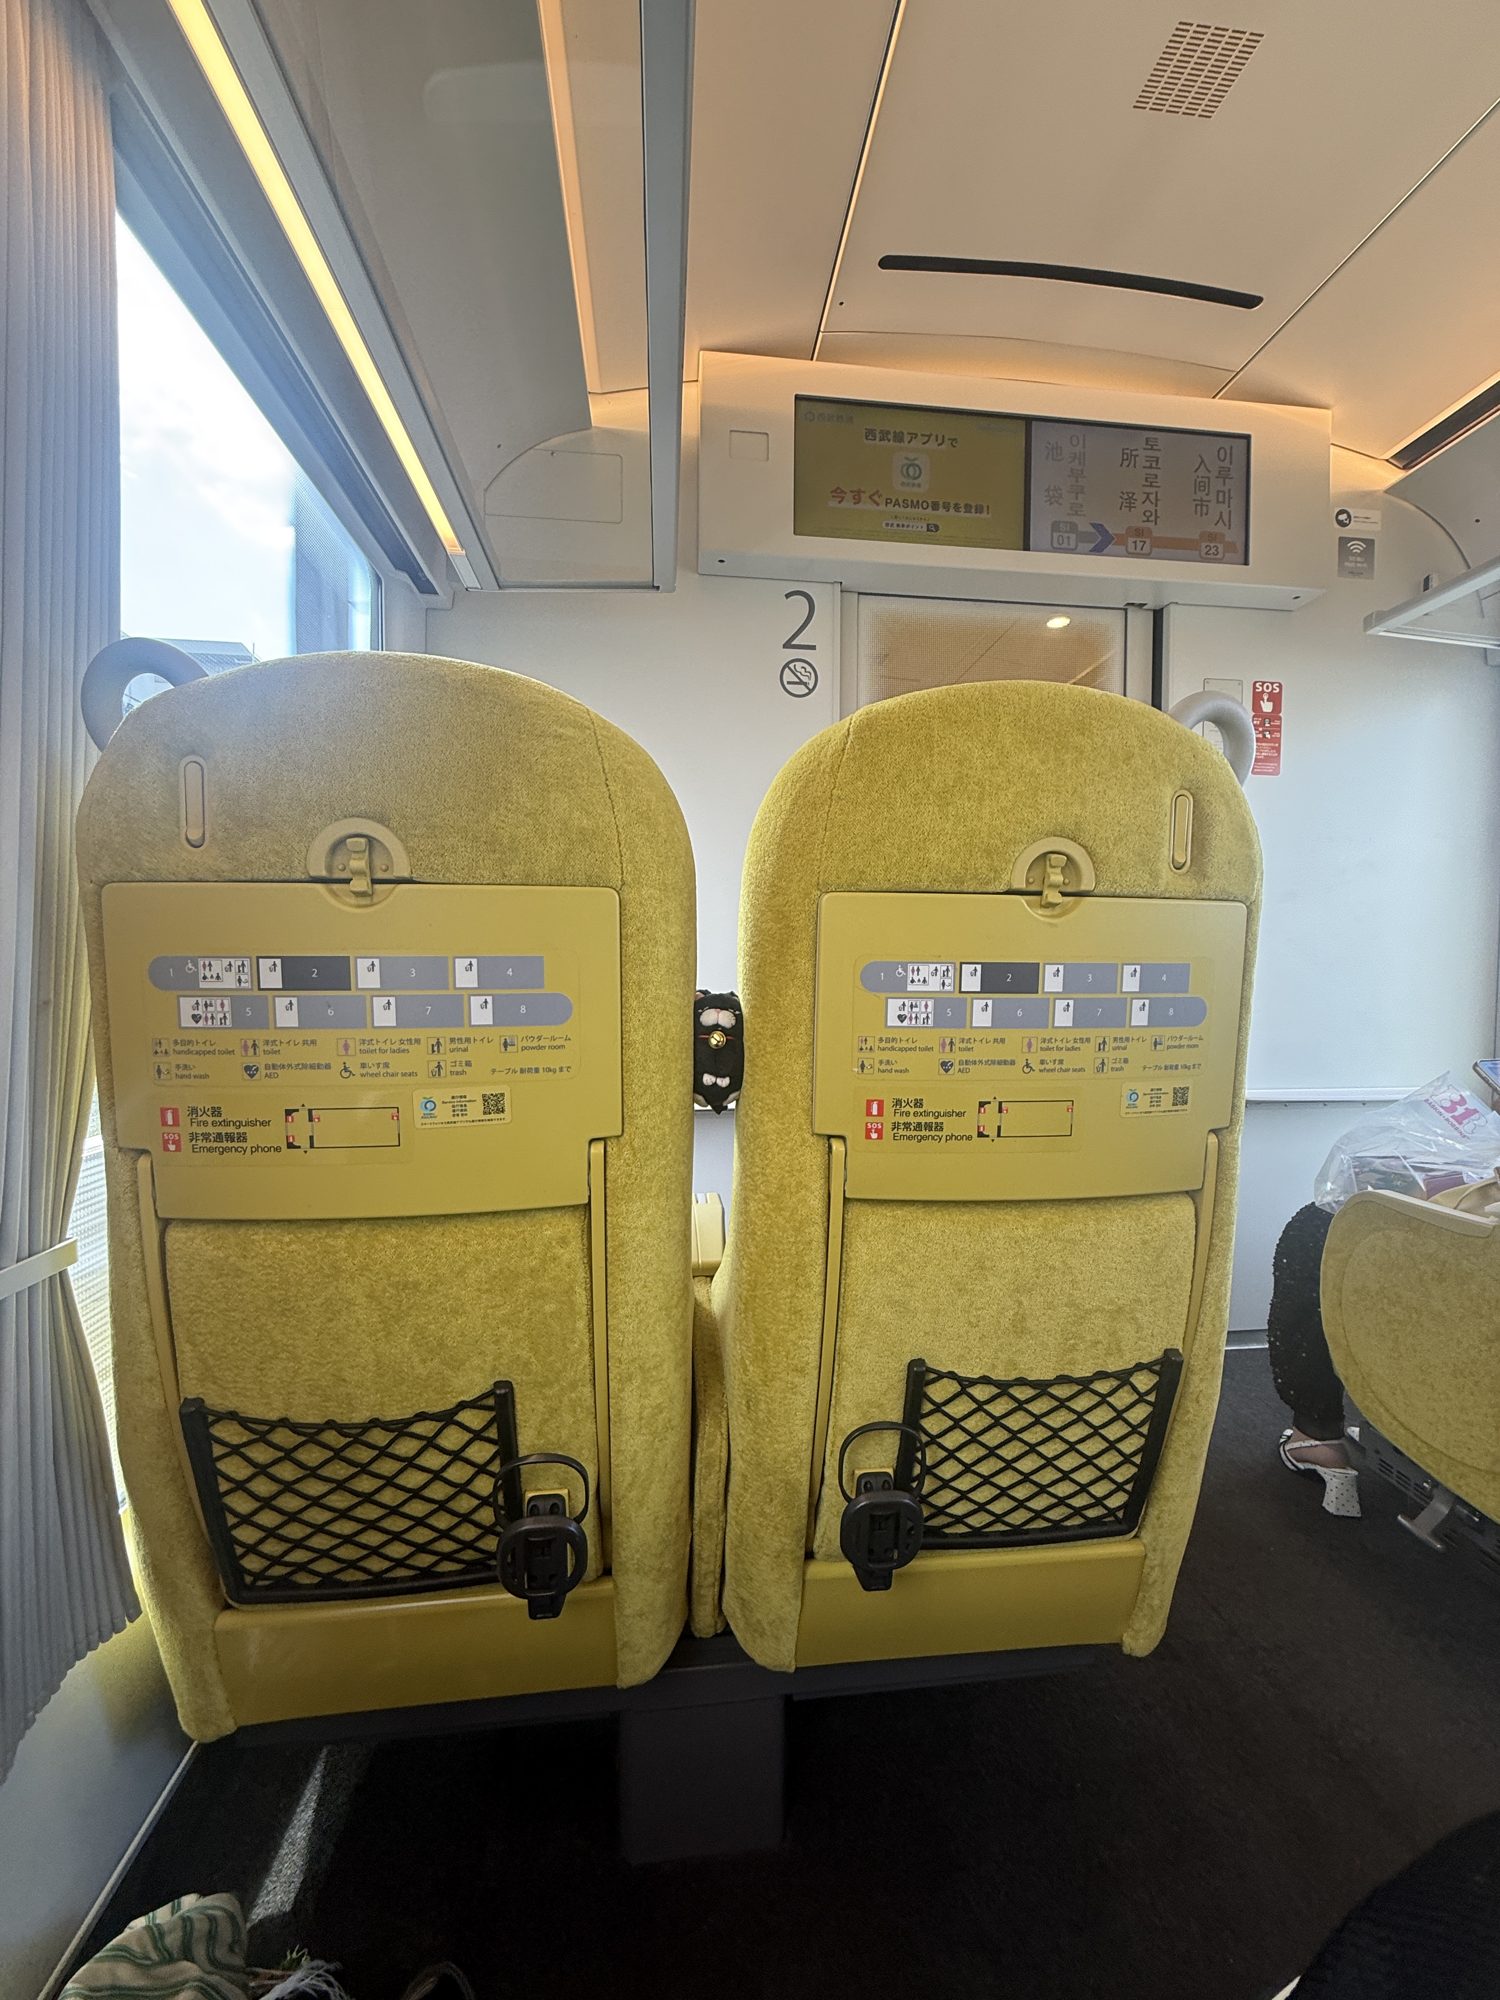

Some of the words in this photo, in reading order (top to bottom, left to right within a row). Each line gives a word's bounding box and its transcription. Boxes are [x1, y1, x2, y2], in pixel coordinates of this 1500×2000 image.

[865, 428, 958, 448] 西武線アプリで
[1142, 437, 1161, 526] 토코로자와
[1215, 446, 1233, 530] 이루마시
[1134, 528, 1144, 536] SI
[1057, 534, 1072, 546] 01
[1132, 540, 1146, 551] 17
[1205, 545, 1219, 556] 23
[782, 590, 816, 650] 2
[1256, 682, 1280, 693] SOS
[312, 969, 318, 977] 2
[410, 969, 416, 977] 3
[506, 968, 513, 976] 4
[1006, 974, 1012, 982] 2
[1088, 974, 1092, 982] 3
[1161, 974, 1167, 982] 4
[246, 1008, 252, 1016] 5
[328, 1007, 334, 1016] 6
[426, 1007, 431, 1015] 7
[520, 1005, 526, 1014] 8
[1017, 1008, 1022, 1016] 6
[1097, 1008, 1102, 1016] 7
[173, 1048, 216, 1056] handicapped
[383, 1070, 399, 1078] chair
[542, 1067, 557, 1075] 10kg
[892, 1098, 923, 1108] 消火器
[187, 1106, 222, 1117] 消火器
[894, 1109, 910, 1117] Fire
[913, 1109, 966, 1119] extinguisher
[190, 1118, 209, 1126] Fire
[212, 1119, 272, 1128] extinguisher
[891, 1121, 944, 1132] 非常通報器
[189, 1132, 247, 1143] 非常通報器
[893, 1133, 943, 1143] Emergency
[945, 1134, 972, 1143] phone
[192, 1144, 248, 1155] Emergency
[251, 1144, 282, 1154] phone
